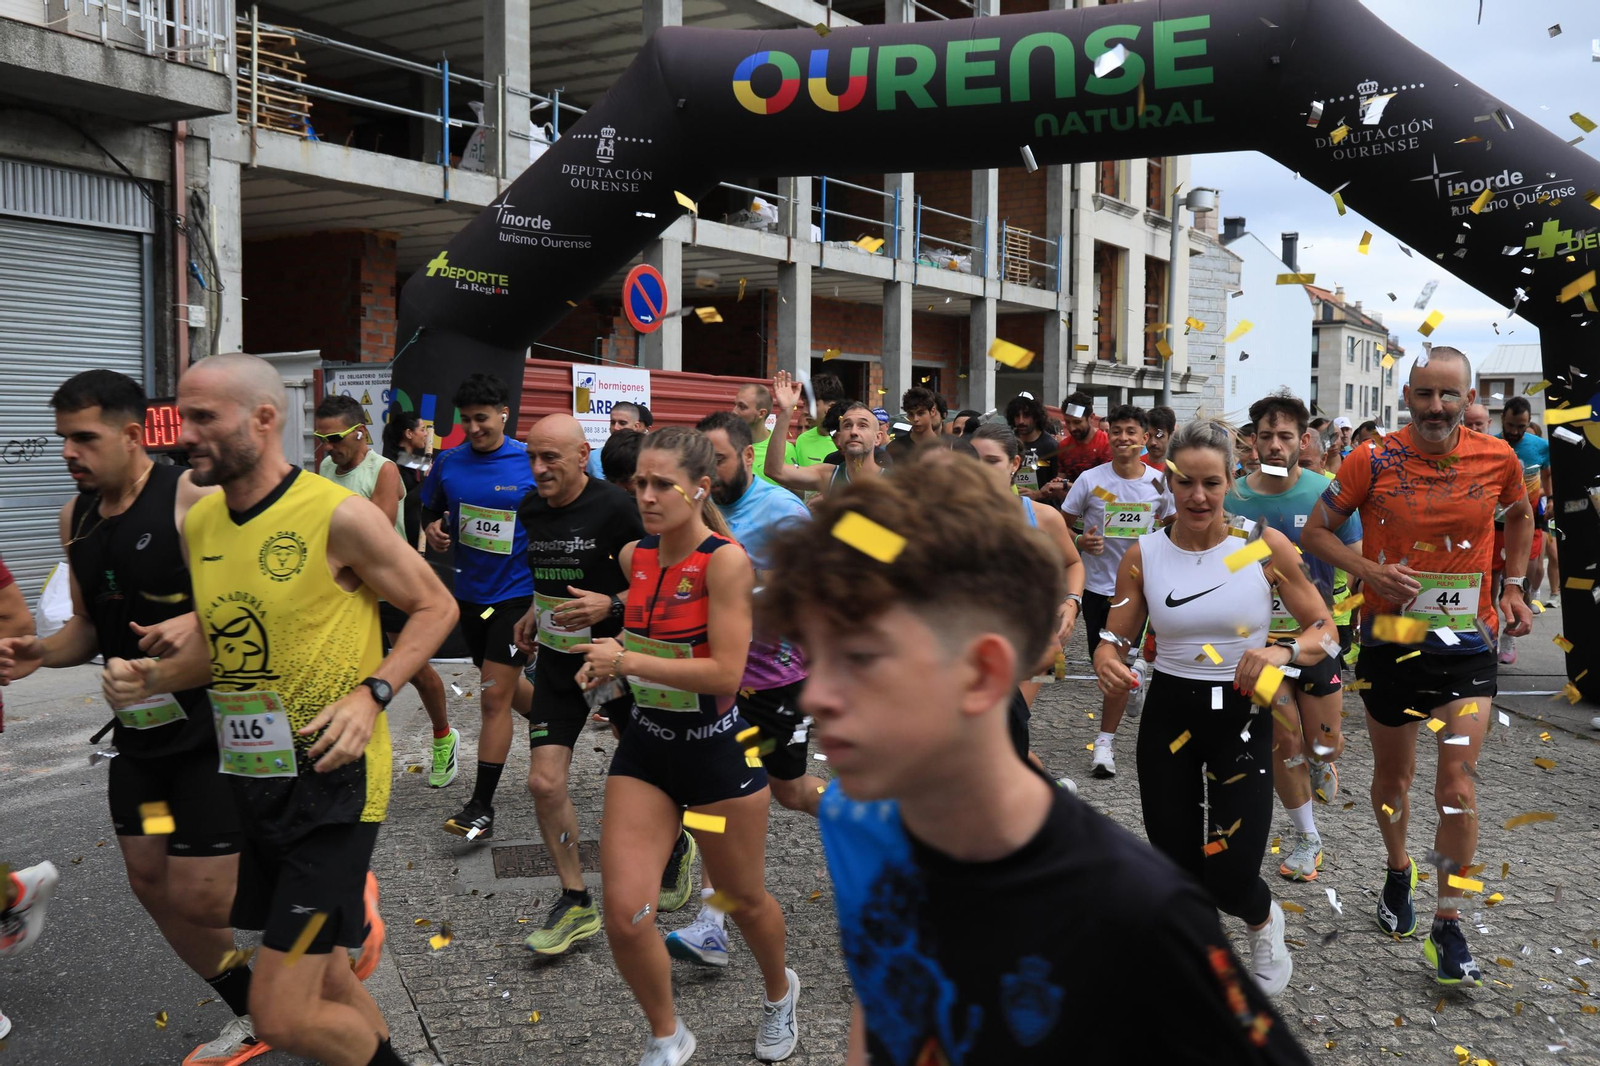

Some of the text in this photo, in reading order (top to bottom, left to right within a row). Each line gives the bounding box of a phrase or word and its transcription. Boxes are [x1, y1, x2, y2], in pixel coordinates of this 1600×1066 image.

[733, 14, 1215, 116] OURENSE
[1034, 99, 1216, 138] NATURAL
[1333, 136, 1420, 161] OURENSE
[561, 163, 653, 181] DEPUTACIÓN
[570, 177, 640, 193] OURENSE
[1447, 169, 1524, 197] inorde
[1513, 185, 1577, 207] Ourense
[501, 210, 552, 231] inorde
[498, 230, 592, 250] turismo Ourense
[454, 279, 469, 290] La
[598, 379, 645, 394] hormigones
[476, 520, 500, 534] 104
[1120, 513, 1141, 522] 224
[1436, 592, 1460, 606] 44
[230, 719, 264, 740] 116
[639, 716, 676, 740] PRO
[686, 714, 733, 740] NIKE
